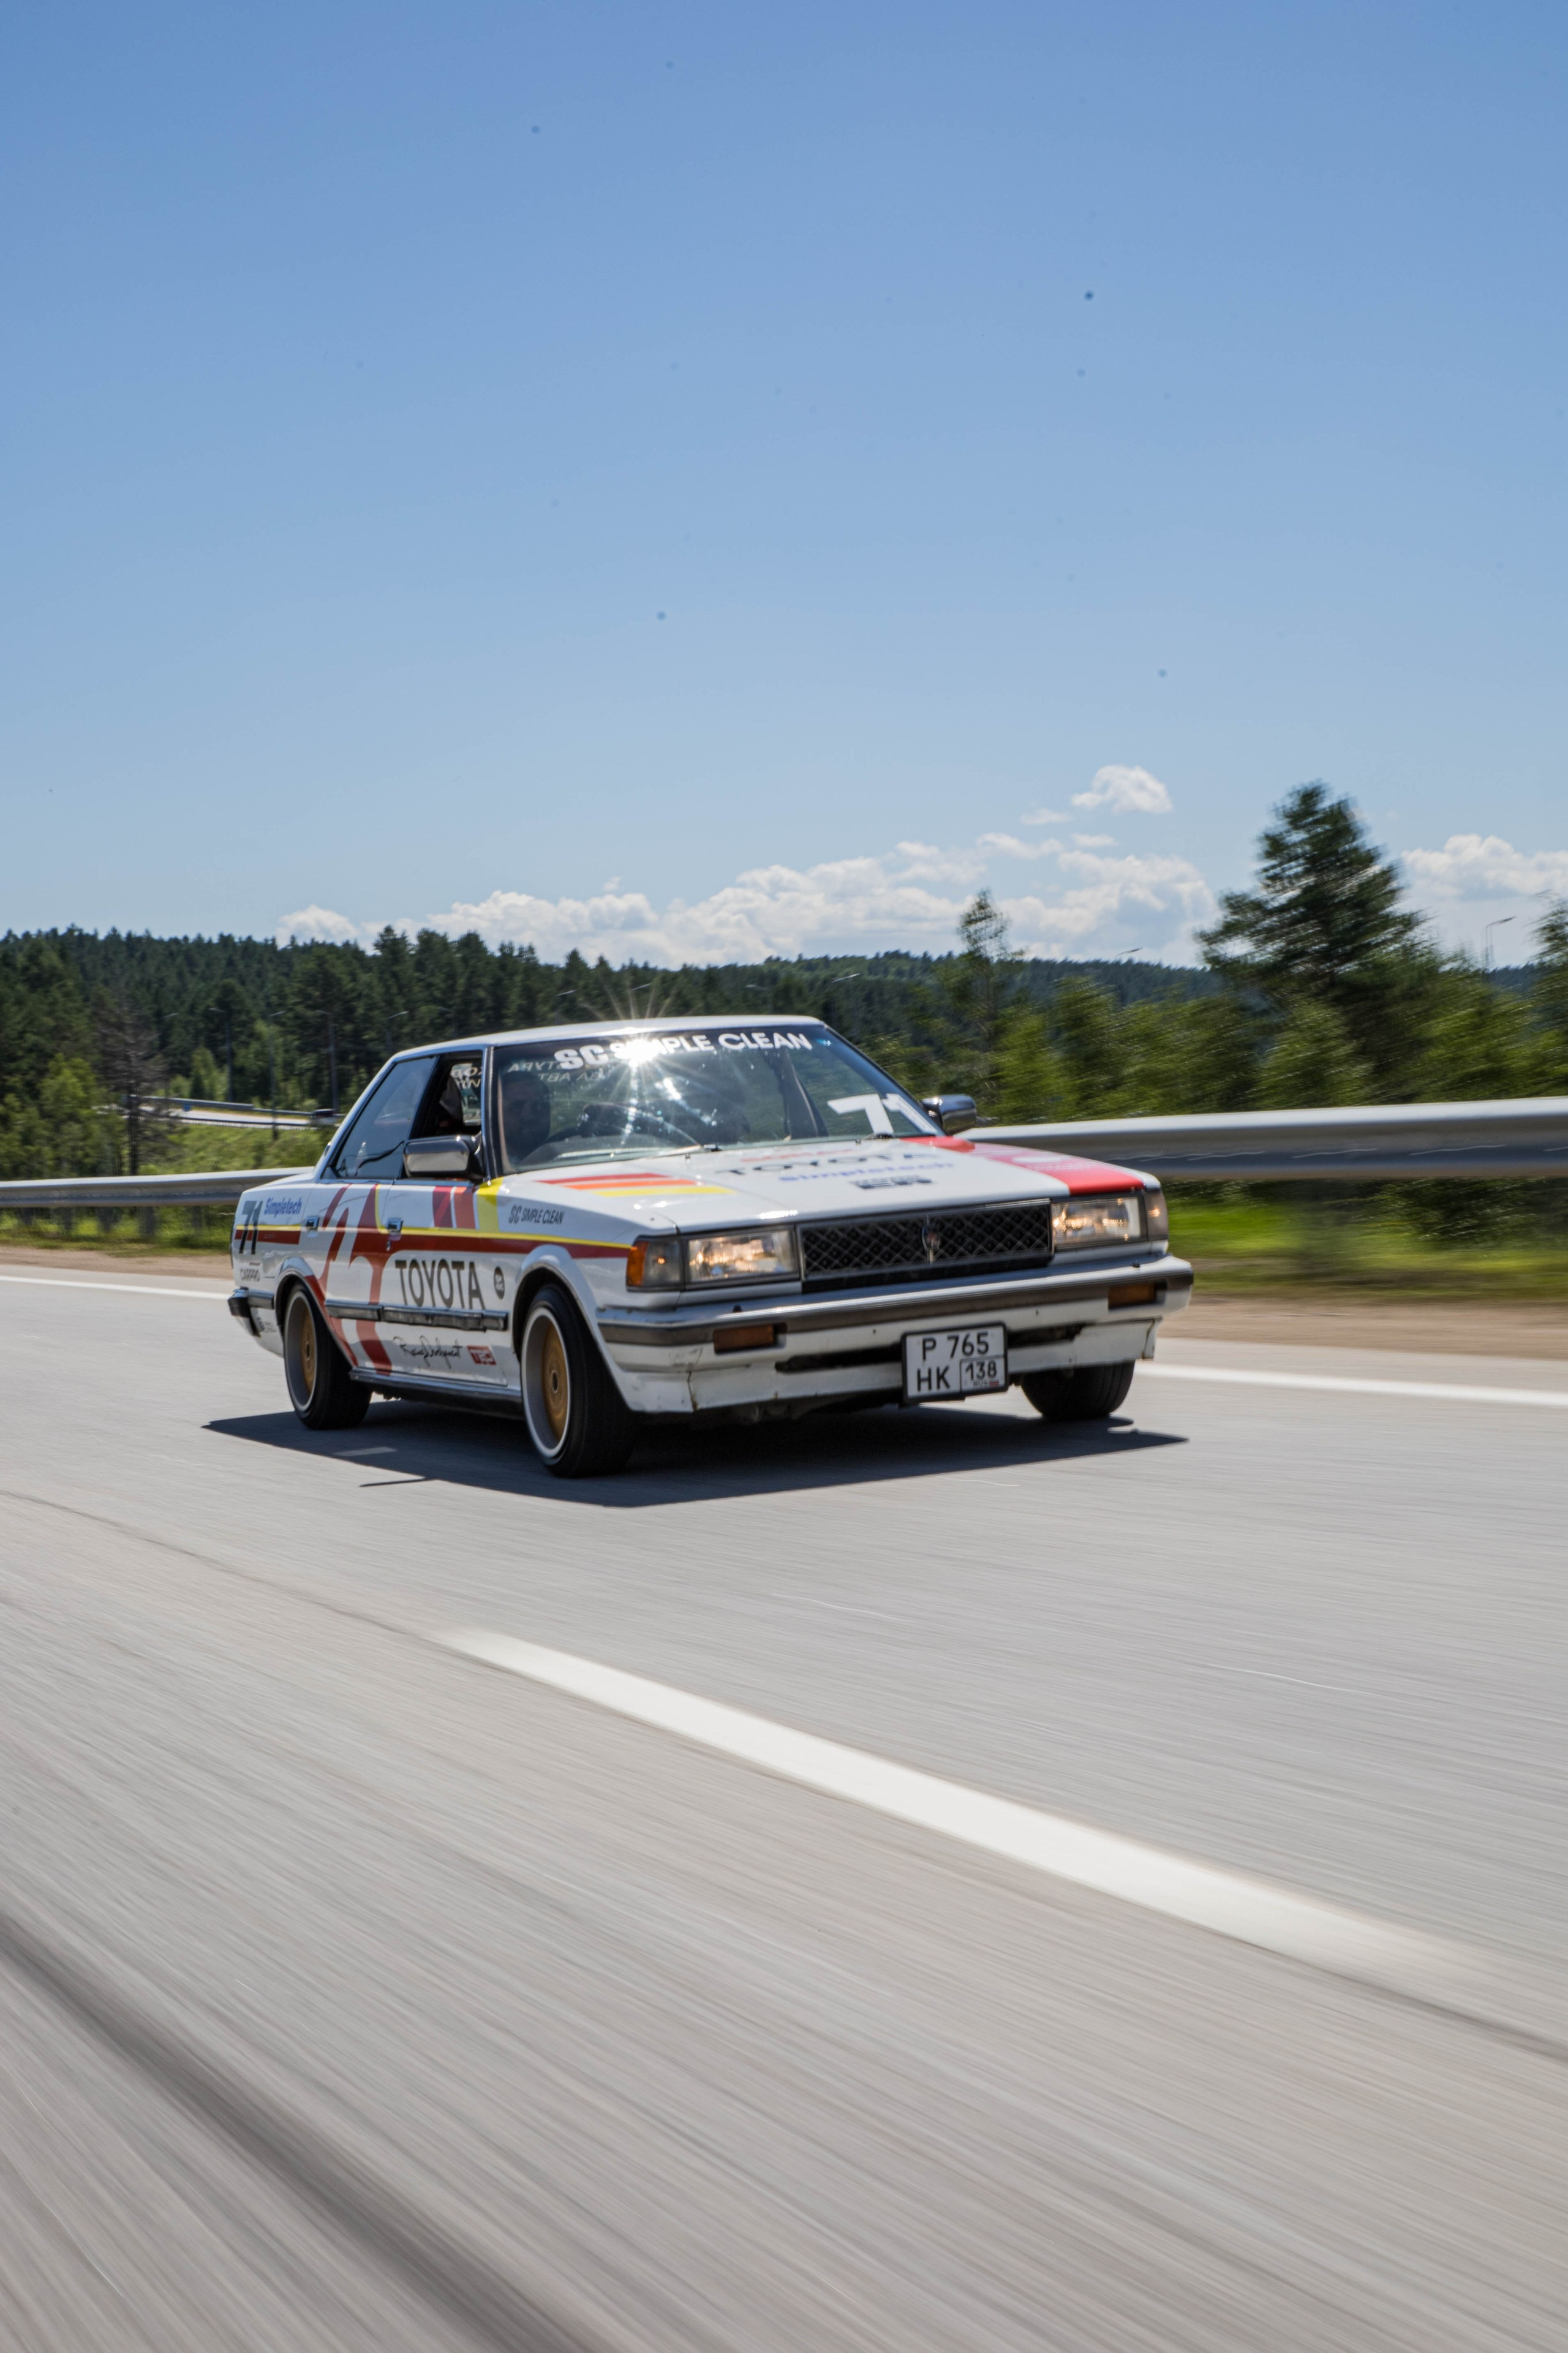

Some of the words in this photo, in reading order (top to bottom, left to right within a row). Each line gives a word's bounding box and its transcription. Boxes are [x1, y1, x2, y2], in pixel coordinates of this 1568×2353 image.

[554, 1044, 609, 1070] SC
[609, 1035, 715, 1059] SPLE
[718, 1033, 813, 1050] CLEAN
[827, 1093, 937, 1135] 71
[264, 1197, 303, 1218] Simpletech
[508, 1205, 522, 1224] SC
[521, 1207, 543, 1224] SIMPLE
[542, 1209, 565, 1225] CLEAN
[239, 1201, 263, 1255] 71
[395, 1259, 486, 1310] TOYOTA
[947, 1331, 989, 1359] 765
[965, 1360, 997, 1381] 138
